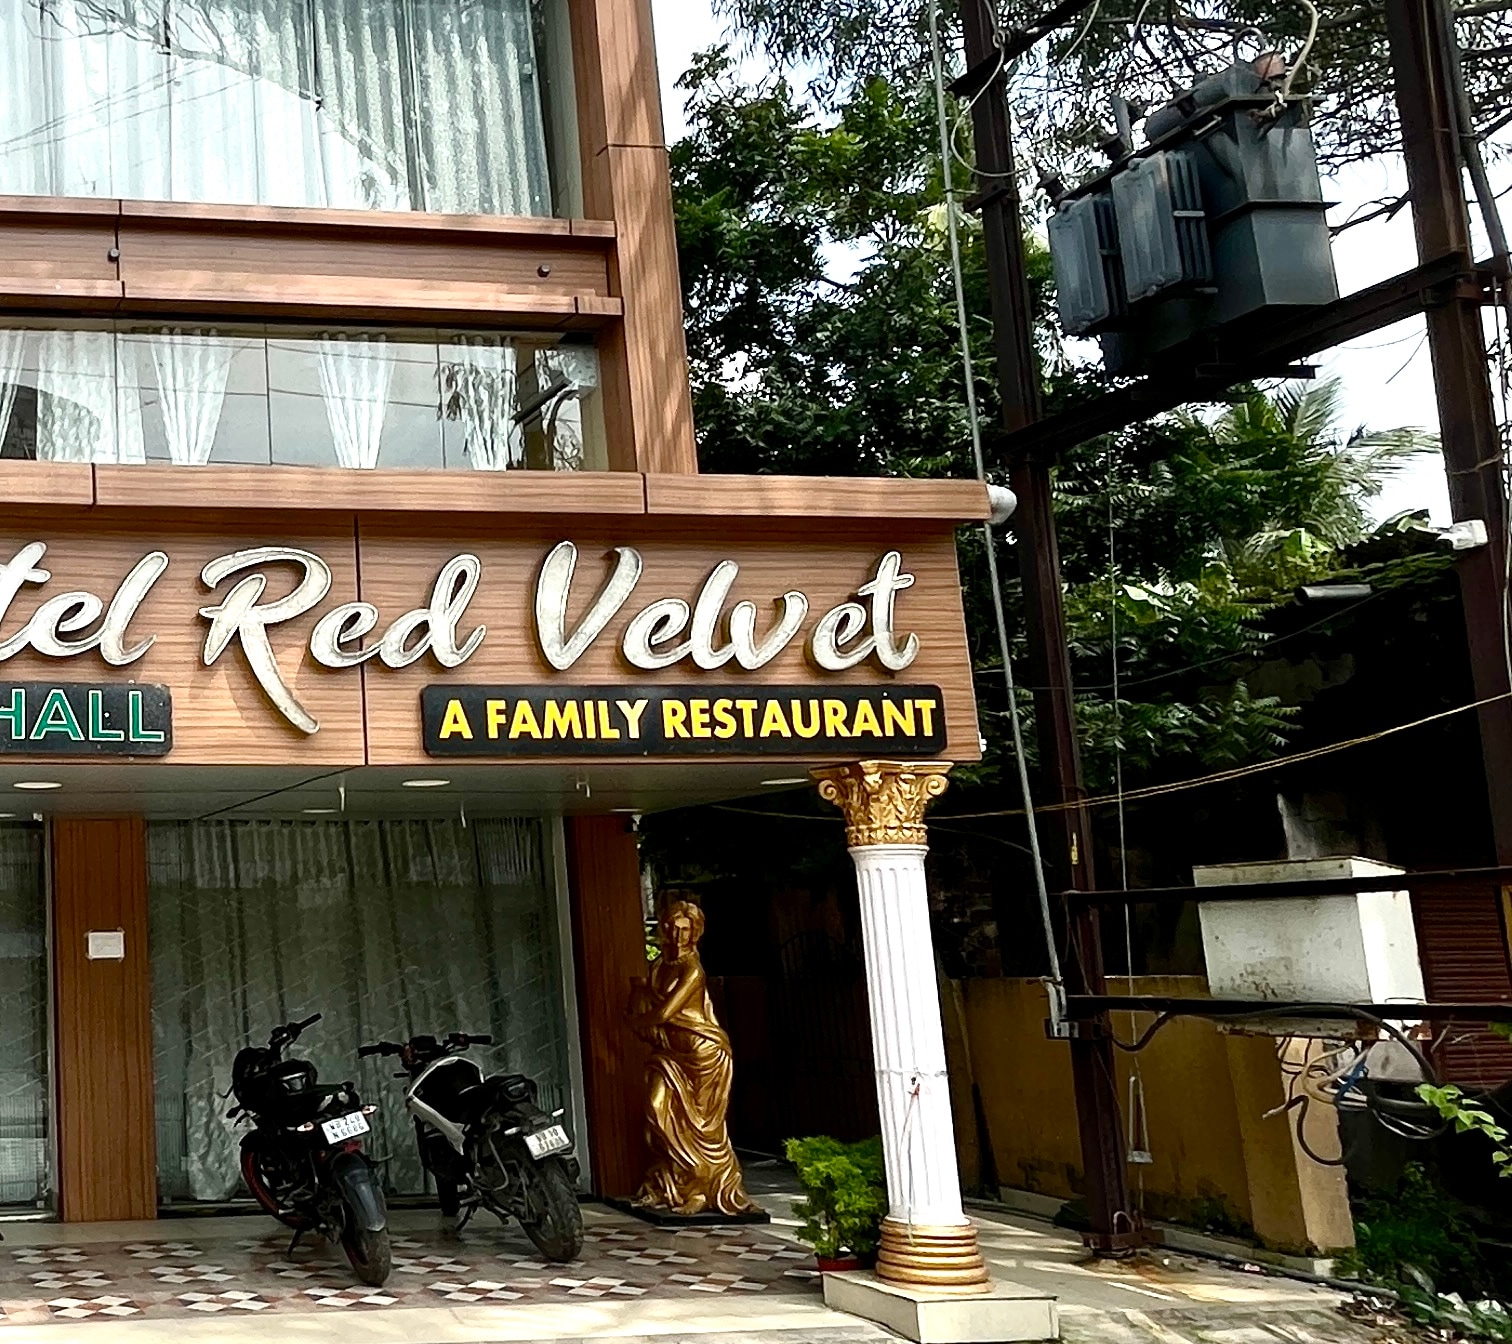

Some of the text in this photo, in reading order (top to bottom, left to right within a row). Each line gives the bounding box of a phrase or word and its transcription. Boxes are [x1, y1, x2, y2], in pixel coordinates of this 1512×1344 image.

[199, 545, 488, 736] Red
[536, 540, 920, 672] Velvet
[439, 698, 936, 740] A FAMILY RESTAURANT
